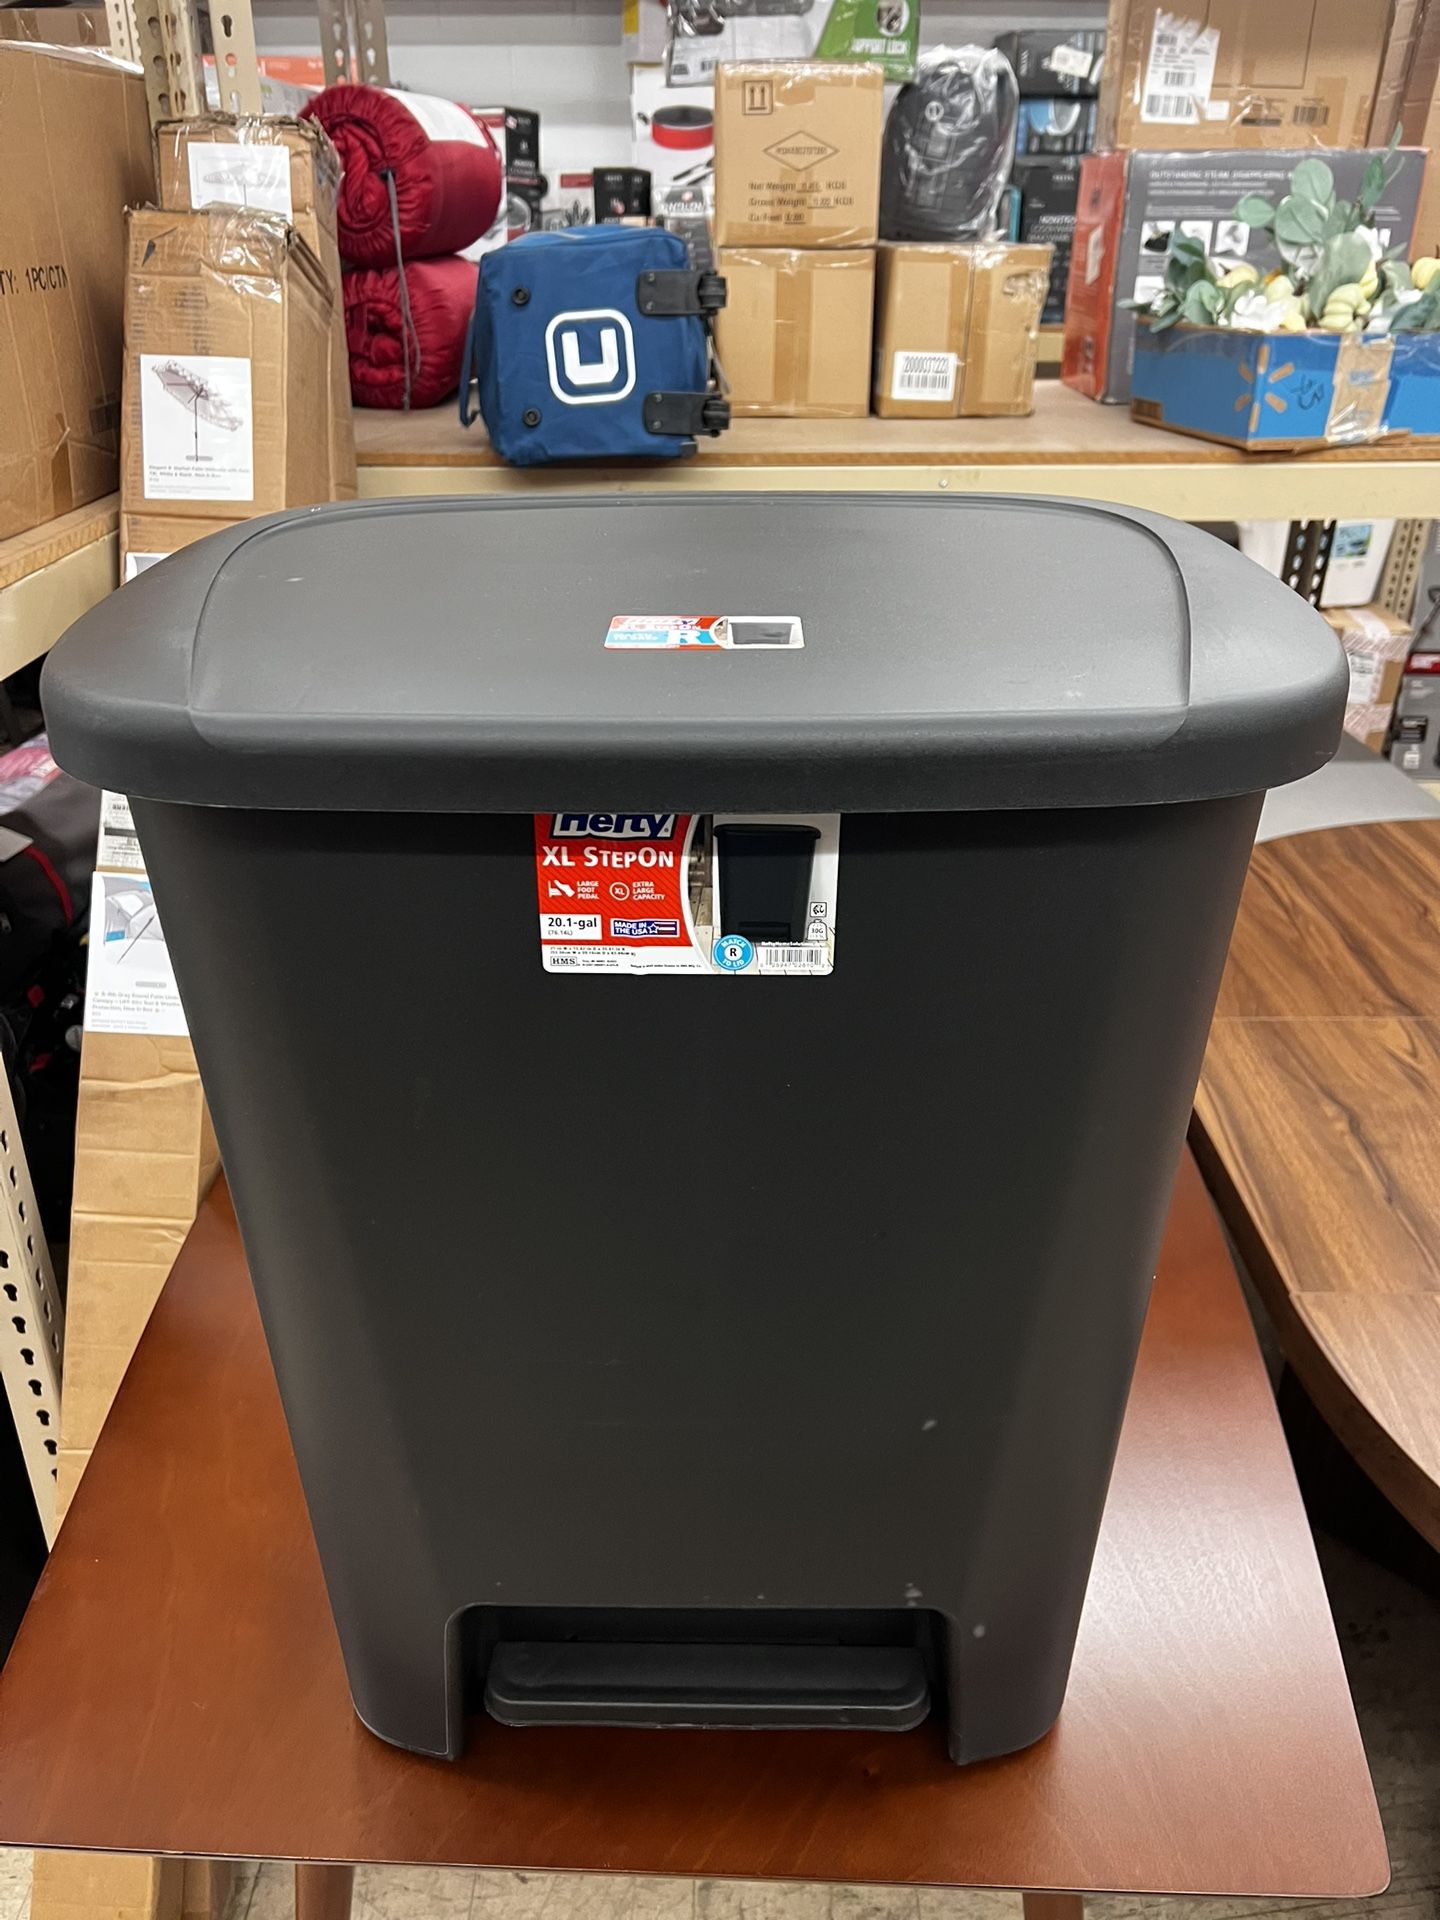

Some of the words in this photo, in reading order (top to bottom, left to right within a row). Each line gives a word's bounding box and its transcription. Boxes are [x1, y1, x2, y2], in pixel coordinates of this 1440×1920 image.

[561, 327, 620, 386] U
[542, 845, 576, 867] XL
[614, 887, 625, 896] XL
[548, 917, 597, 930] 20.1-gal
[614, 921, 637, 929] MADE
[720, 938, 747, 948] MATCH
[729, 947, 738, 957] R
[552, 957, 576, 965] HMS
[733, 959, 745, 967] LID
